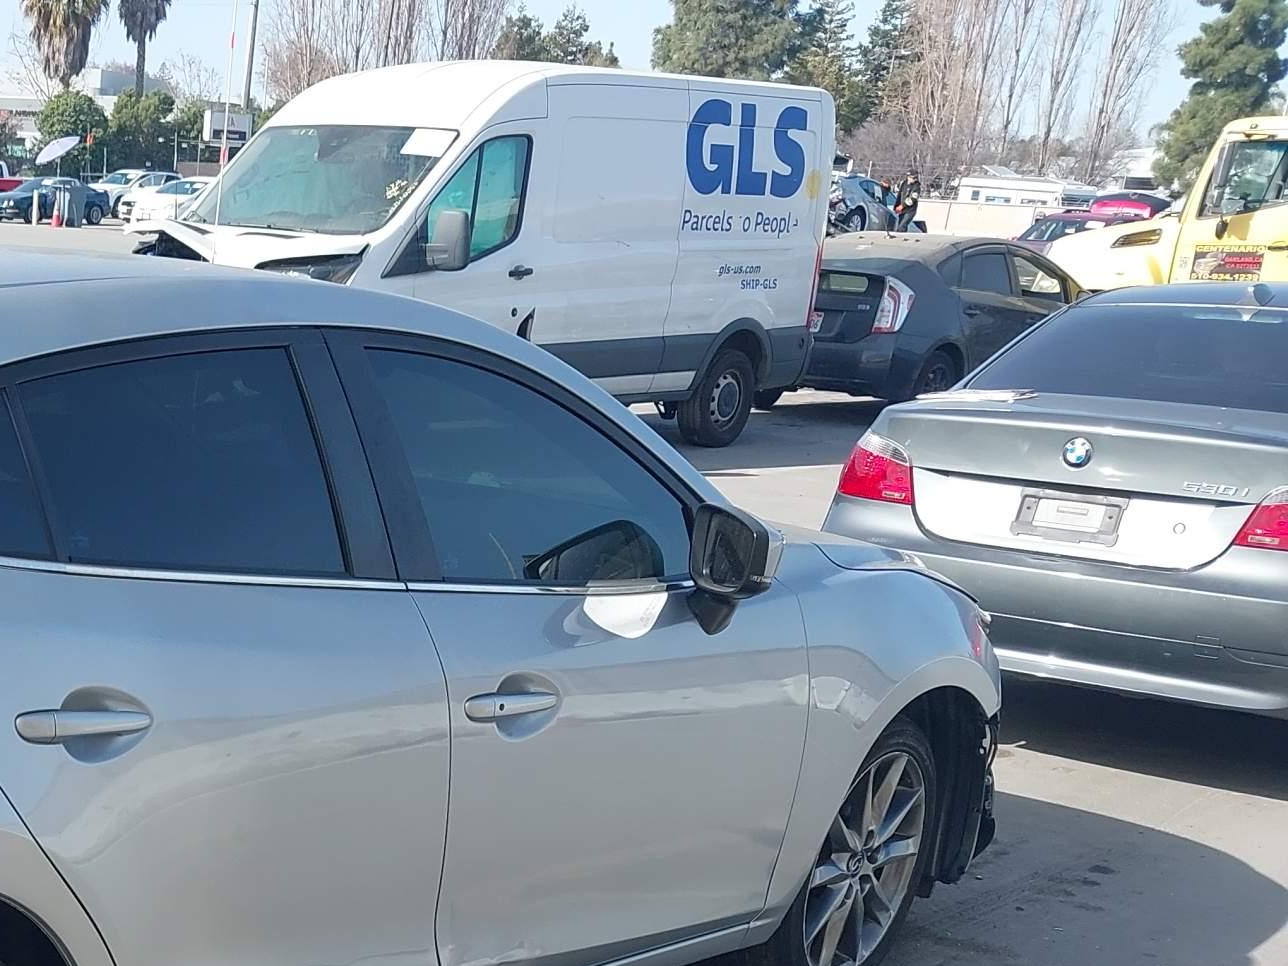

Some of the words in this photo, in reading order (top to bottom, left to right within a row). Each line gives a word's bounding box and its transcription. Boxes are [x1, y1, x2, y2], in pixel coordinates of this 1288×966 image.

[686, 98, 808, 198] GLS
[681, 209, 733, 232] Parcels
[718, 263, 761, 277] gls-us.com
[740, 278, 778, 290] SHIP-GLS
